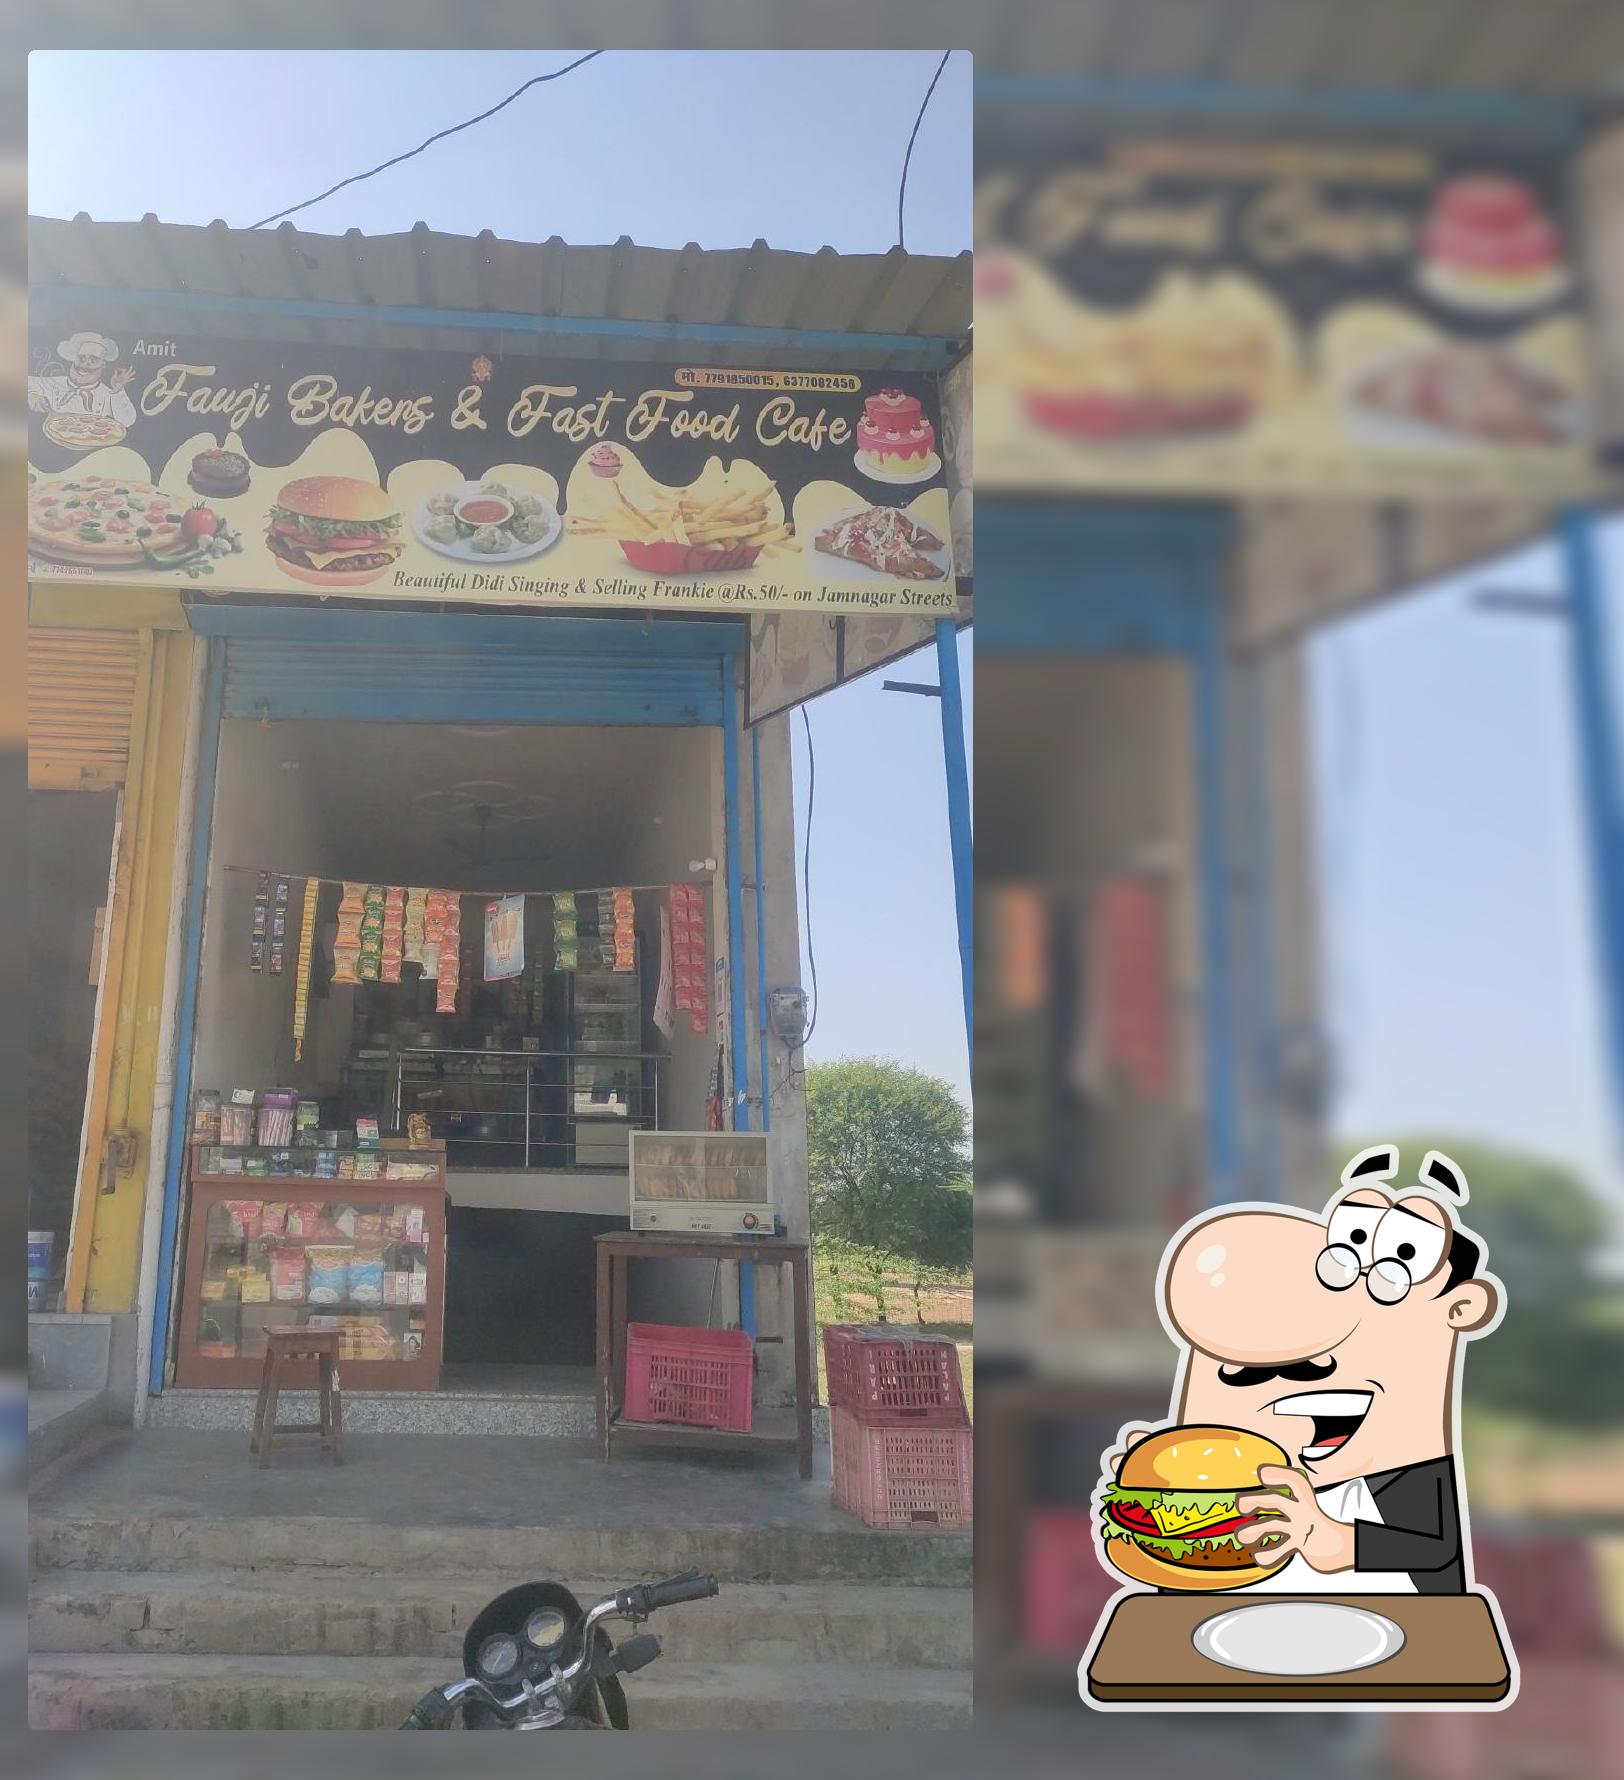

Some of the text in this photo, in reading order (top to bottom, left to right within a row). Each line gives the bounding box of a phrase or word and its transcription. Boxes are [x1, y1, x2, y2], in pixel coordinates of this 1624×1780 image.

[134, 340, 177, 357] Amit
[141, 363, 852, 451] Fauji Bakers & Fast Food Cafe
[393, 570, 467, 593] Beautiful
[471, 573, 505, 592] Didi
[508, 575, 570, 598] Singing
[575, 578, 588, 594] &
[592, 578, 648, 600] Selling
[653, 580, 715, 600] Frankie
[793, 588, 813, 602] on
[817, 586, 897, 608] Jamnagar
[900, 588, 954, 607] Streets
